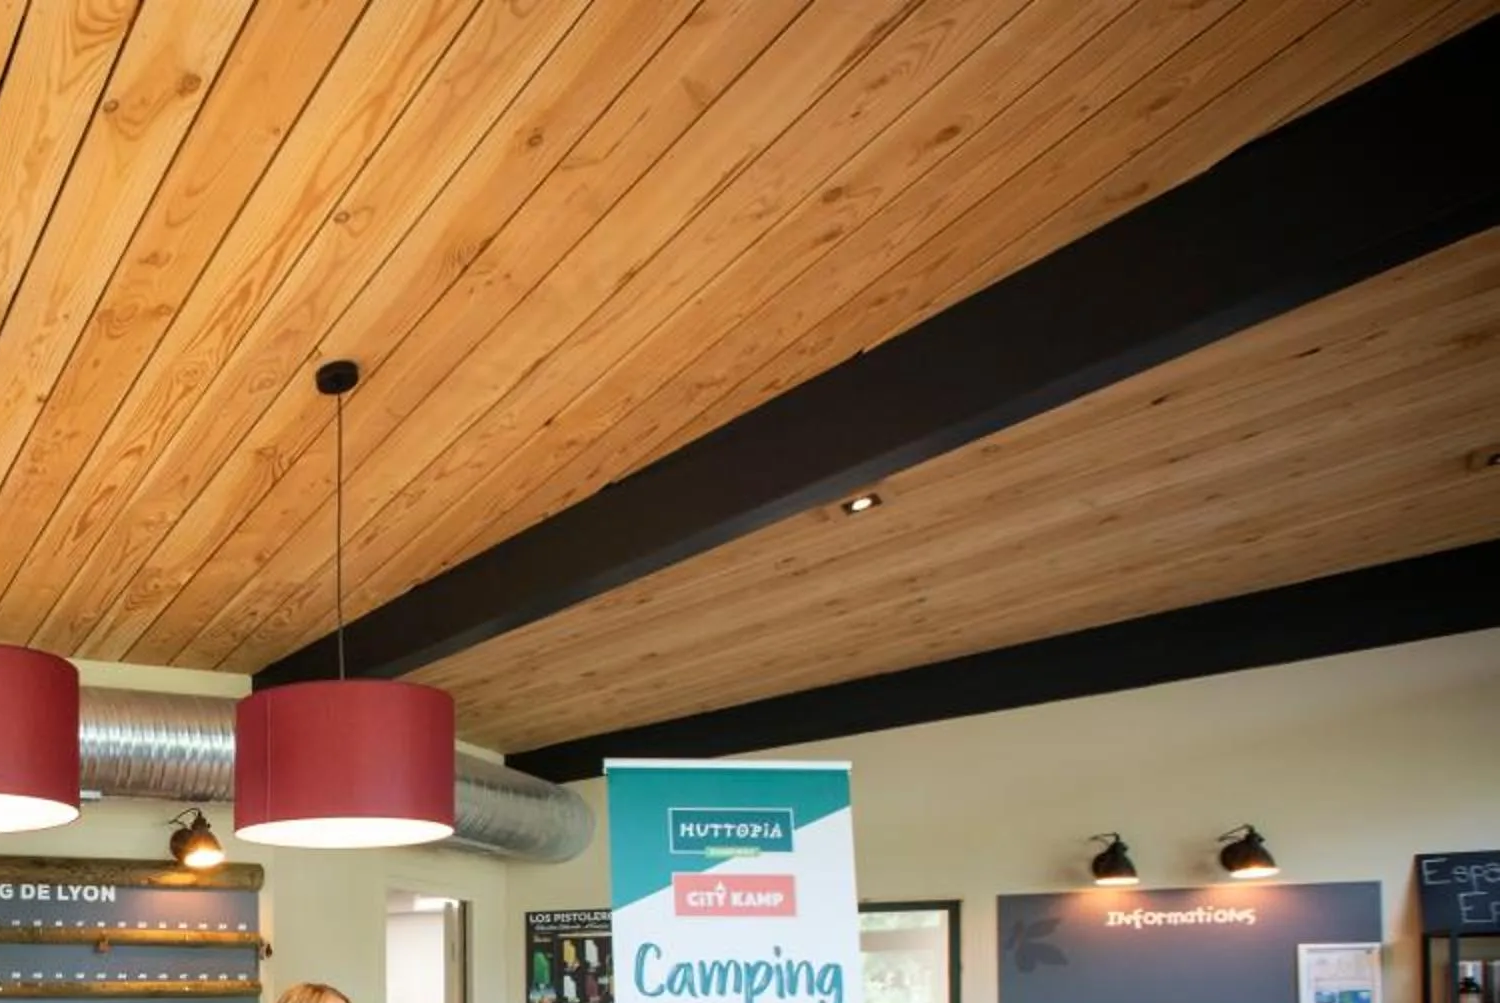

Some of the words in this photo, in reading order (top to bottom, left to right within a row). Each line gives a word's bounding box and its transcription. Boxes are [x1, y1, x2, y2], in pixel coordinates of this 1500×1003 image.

[680, 822, 783, 838] HUTTOPIA
[20, 884, 50, 900] DE
[57, 885, 116, 902] LYON
[686, 890, 728, 908] CITY
[731, 891, 784, 908] KAMP
[529, 913, 551, 923] LOS
